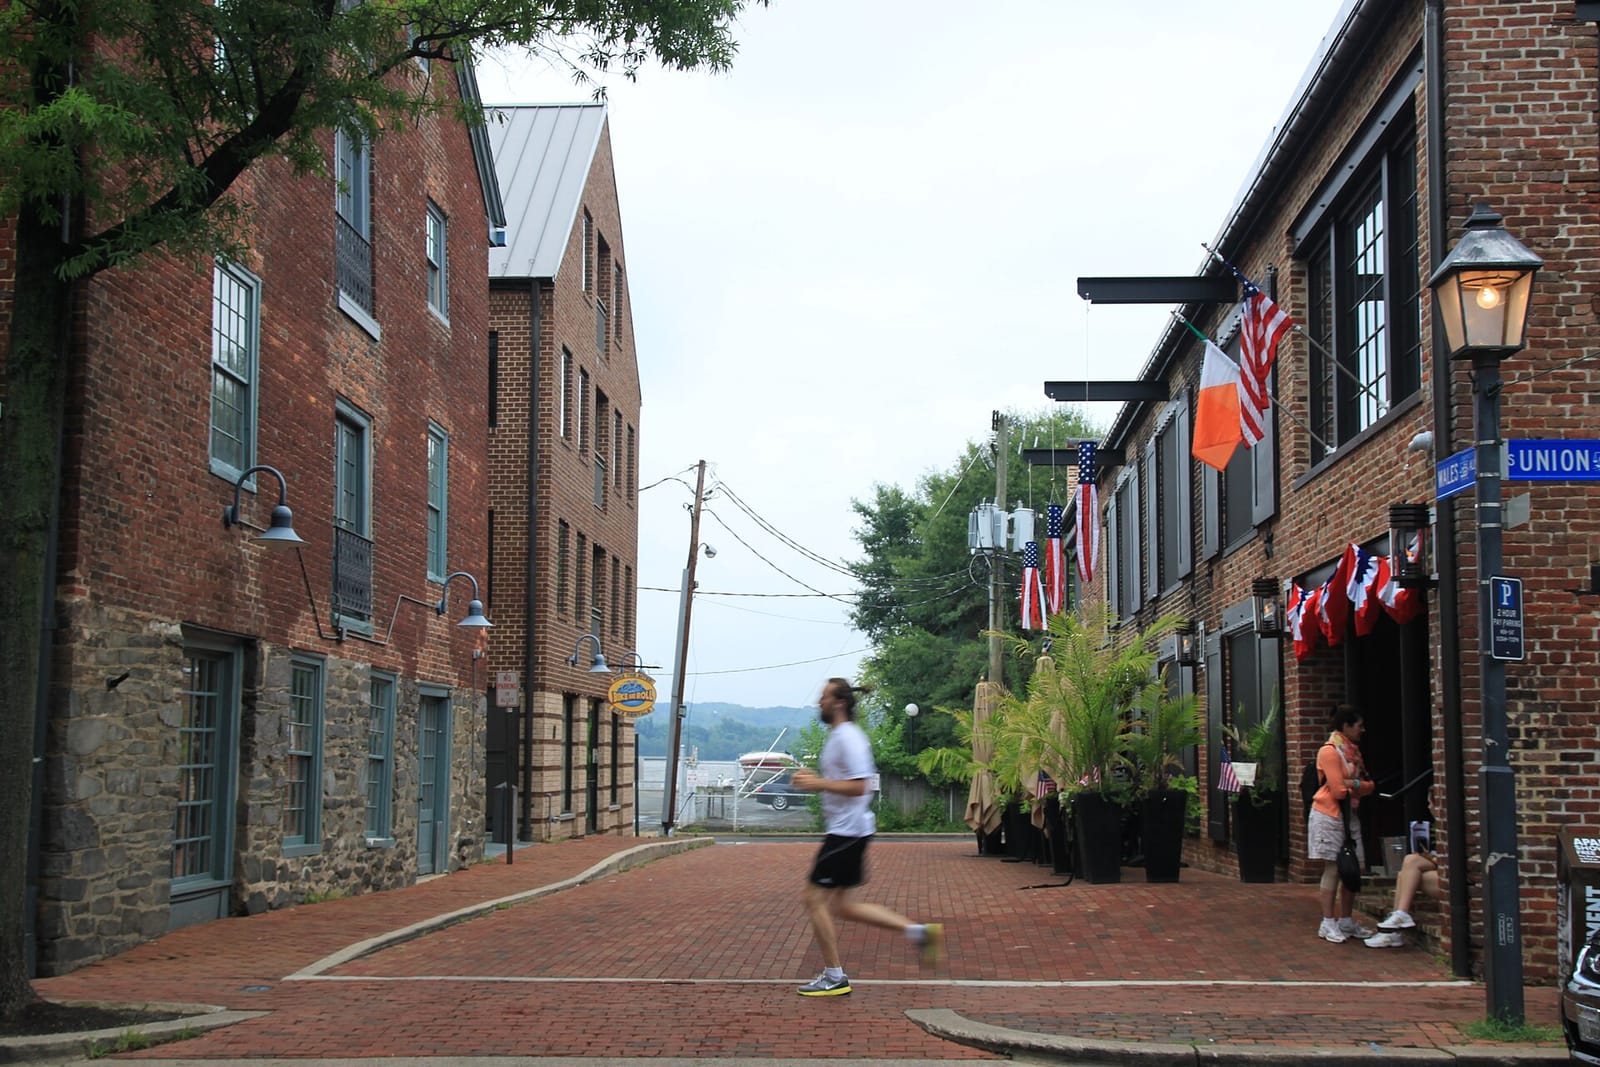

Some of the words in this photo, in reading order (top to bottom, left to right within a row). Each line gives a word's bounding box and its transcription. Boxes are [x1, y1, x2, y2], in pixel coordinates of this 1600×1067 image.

[1520, 449, 1590, 471] UNION
[1438, 464, 1459, 488] WALES
[1501, 583, 1512, 606] P
[1497, 609, 1501, 617] 2
[1502, 609, 1516, 618] HOUR
[1503, 618, 1521, 628] PARKING
